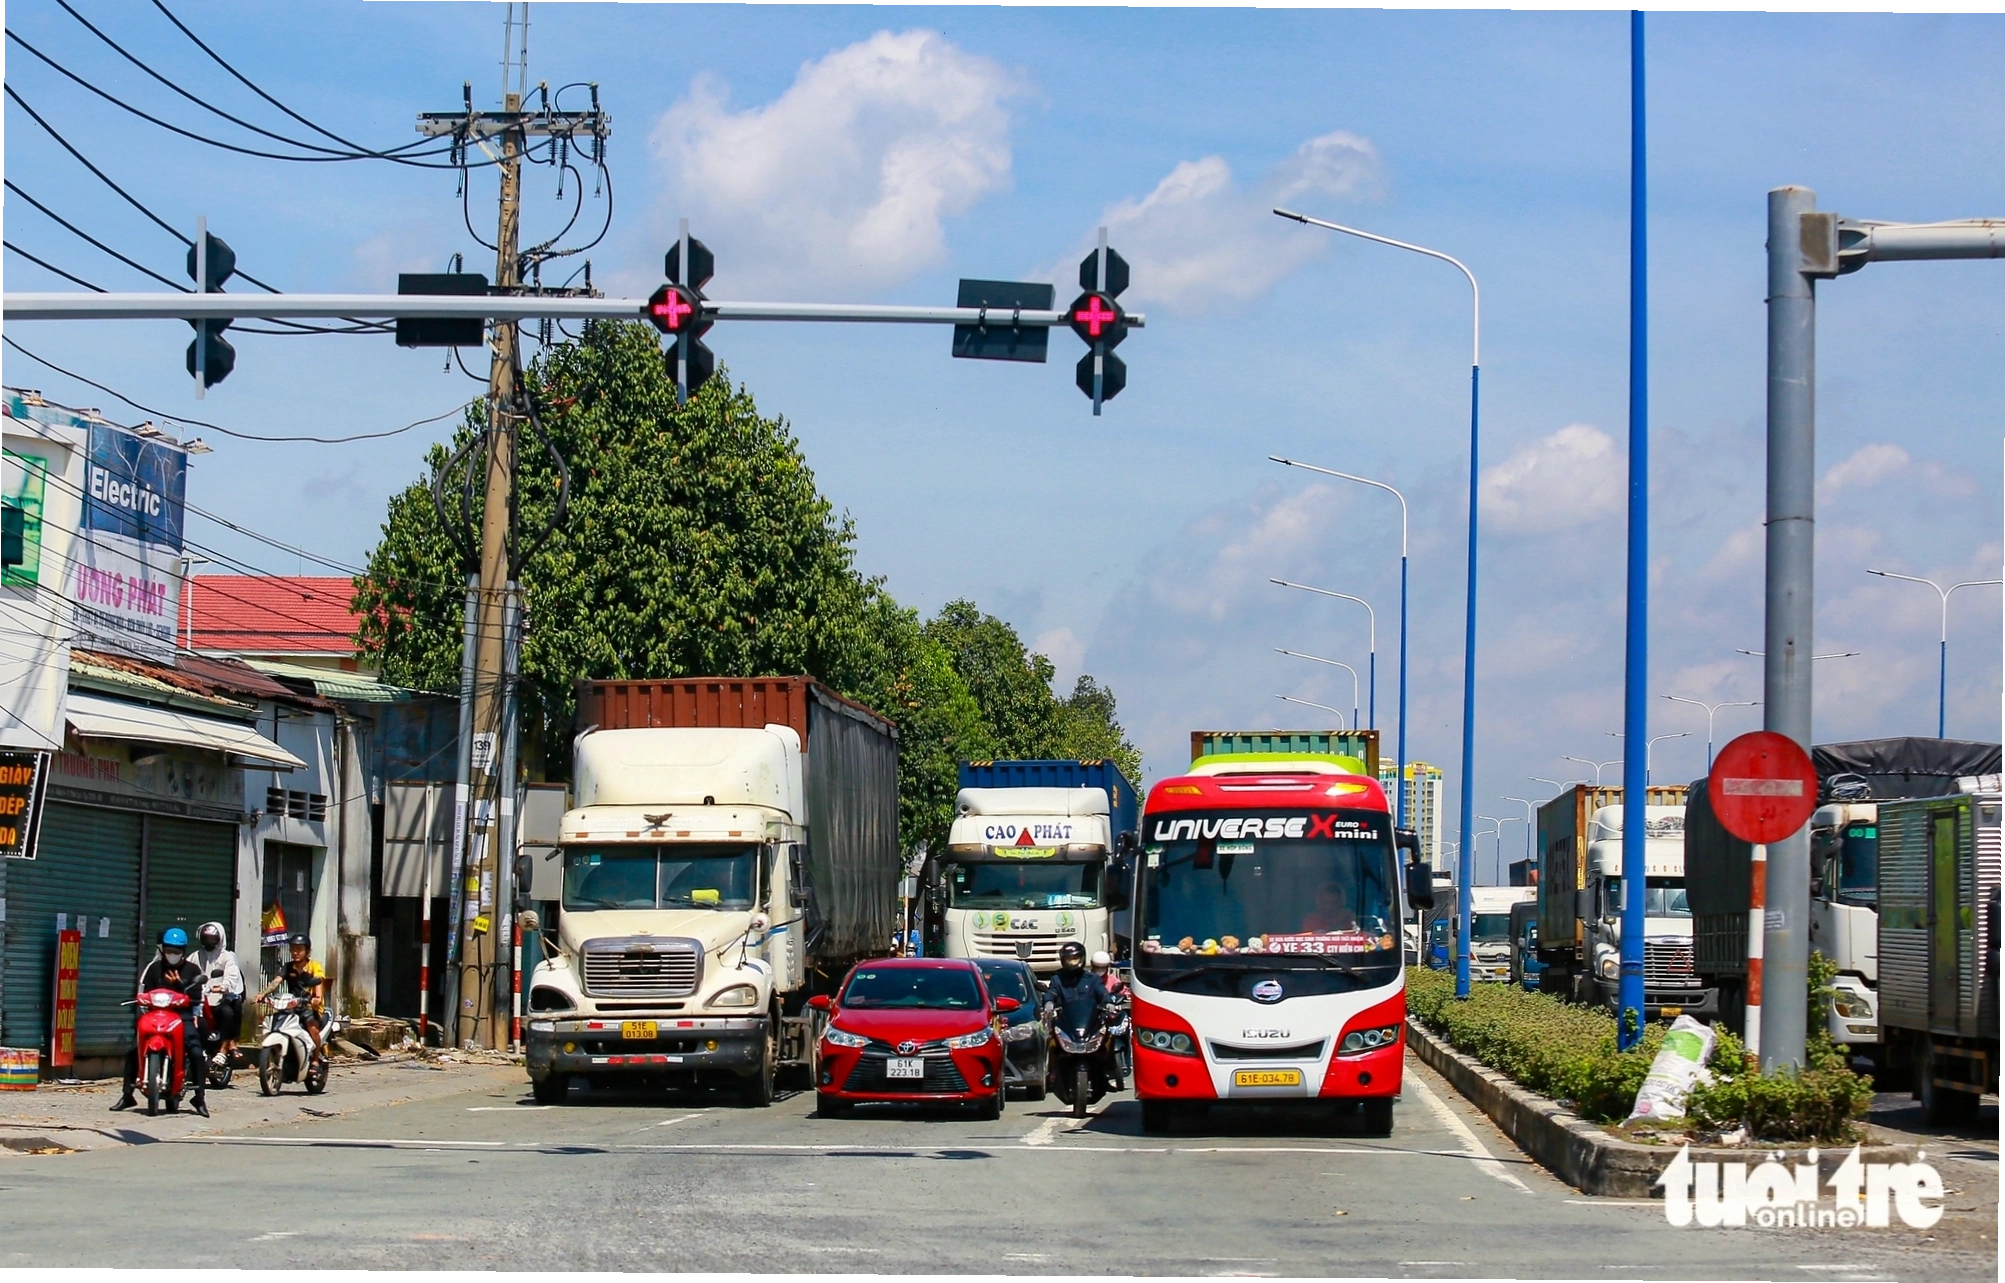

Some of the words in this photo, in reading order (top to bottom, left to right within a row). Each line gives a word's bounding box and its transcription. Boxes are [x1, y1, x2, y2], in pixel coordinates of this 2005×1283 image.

[90, 465, 160, 517] Electric
[474, 740, 491, 751] 139
[0, 763, 32, 785] GIÀY
[985, 825, 1016, 839] CAO
[1034, 822, 1072, 839] PHÁT
[1154, 817, 1307, 842] UNIVERSE
[1306, 814, 1338, 839] X
[0, 827, 16, 846] DA
[1334, 829, 1378, 840] mini
[1010, 919, 1038, 930] C&C
[1282, 942, 1298, 953] XE
[1300, 942, 1325, 953] 33
[632, 1021, 647, 1030] 51E
[626, 1030, 654, 1038] 013.08
[1242, 1029, 1291, 1039] ISUZU
[897, 1059, 914, 1068] 61K
[890, 1068, 920, 1077] 223.18
[1240, 1073, 1295, 1083] 61E-034.78
